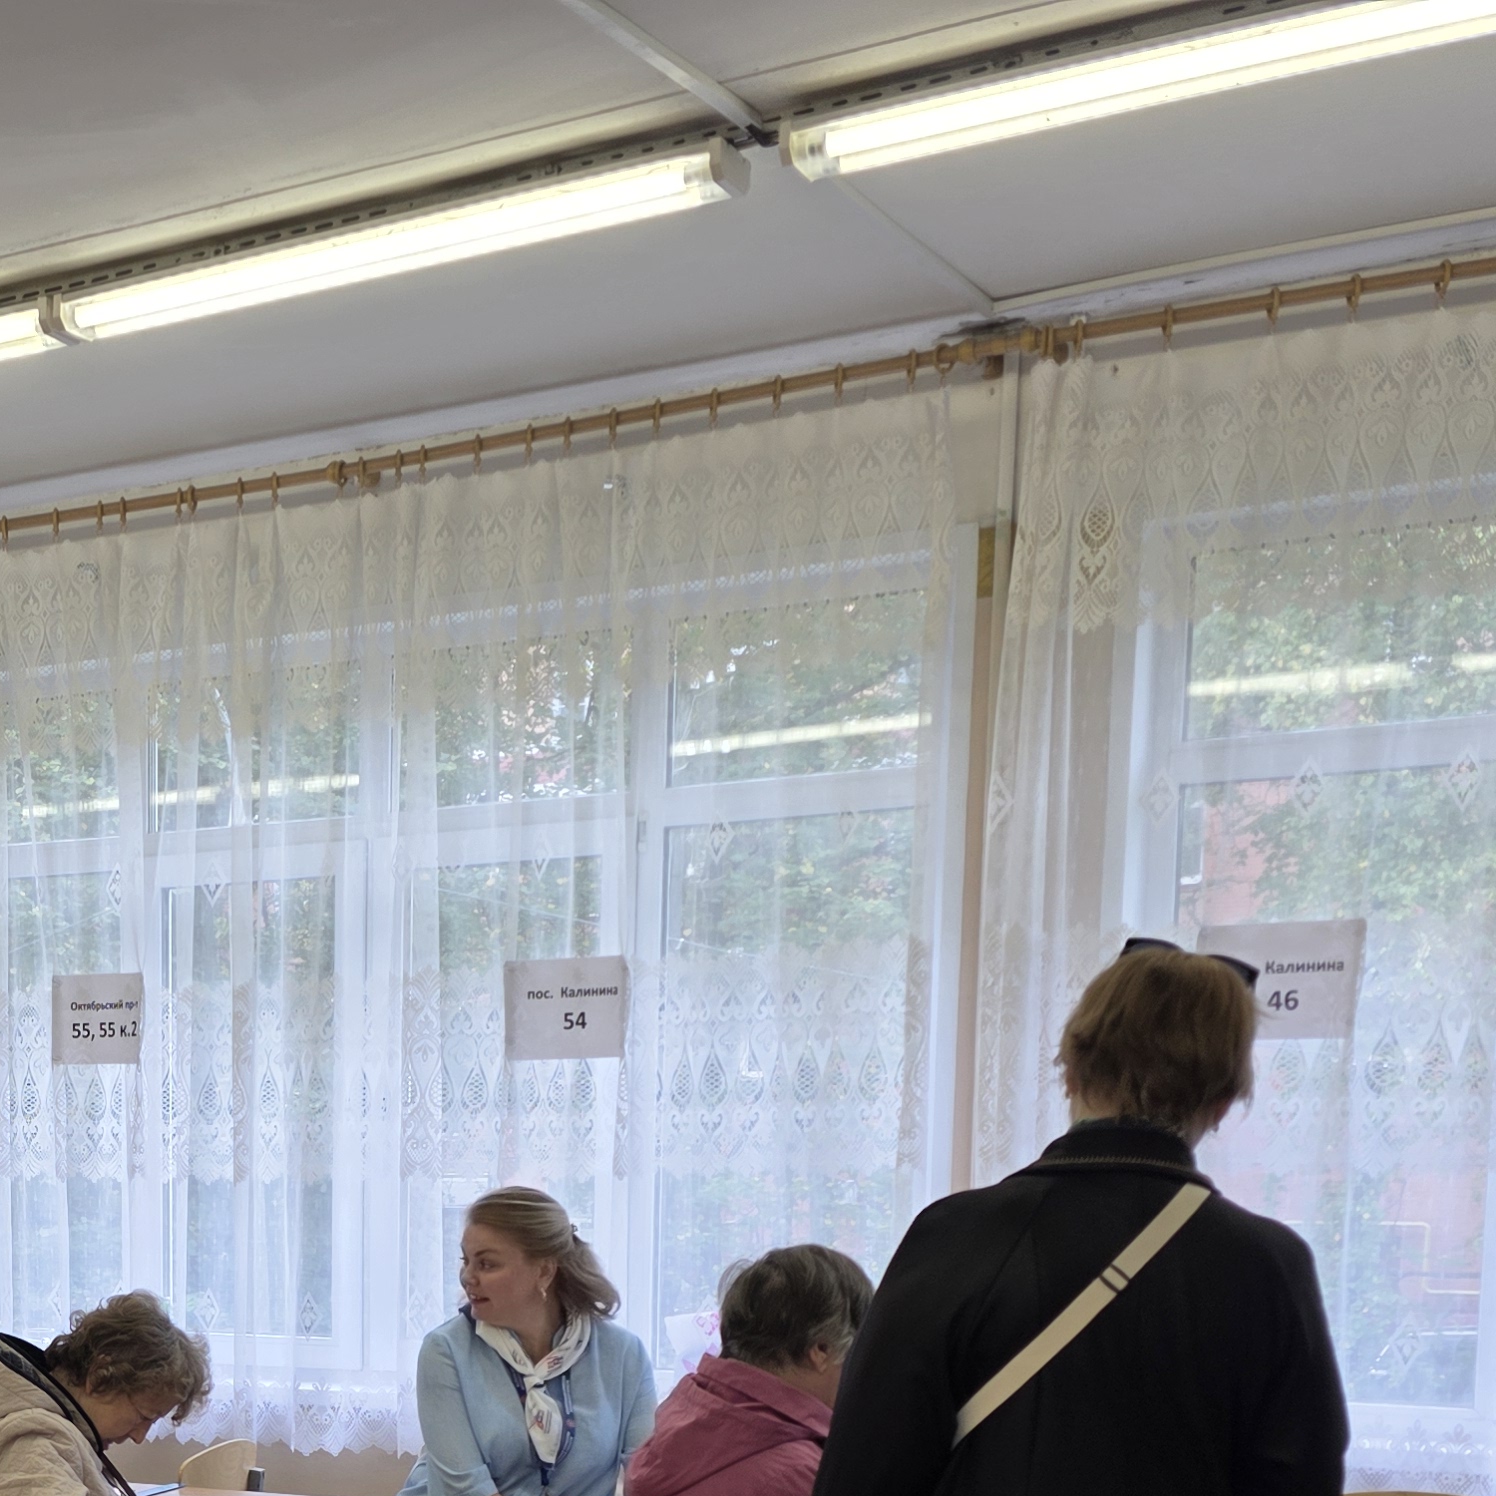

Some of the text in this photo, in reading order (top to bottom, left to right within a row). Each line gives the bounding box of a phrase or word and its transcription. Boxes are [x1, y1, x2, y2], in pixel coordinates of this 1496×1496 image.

[1265, 960, 1345, 975] Калинина
[527, 986, 618, 1000] пос. Калинина
[1267, 990, 1299, 1011] 46
[70, 999, 124, 1012] Октябрьский
[563, 1011, 587, 1030] 54
[72, 1020, 138, 1042] 55, 55 к.2
